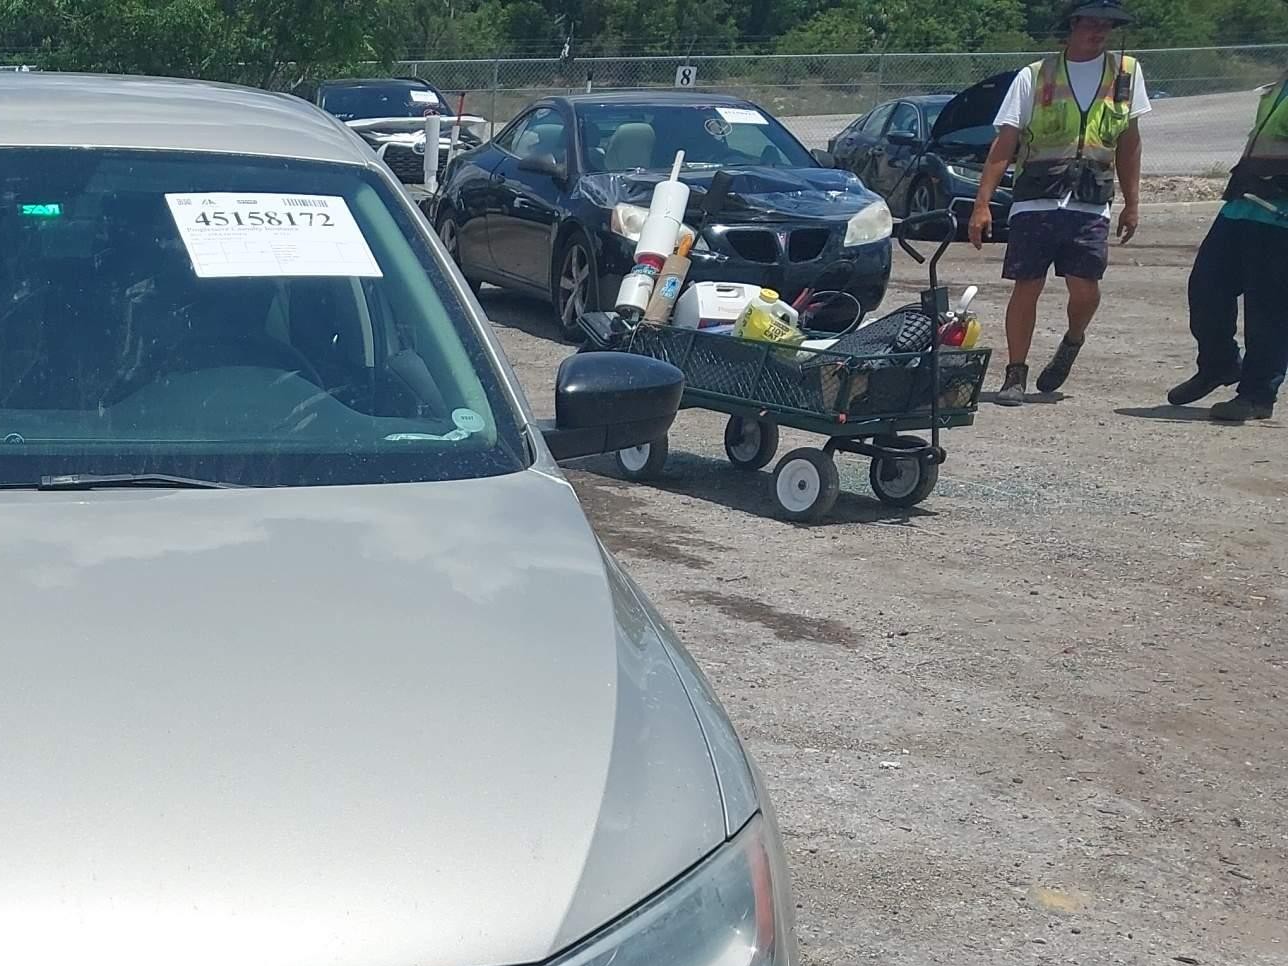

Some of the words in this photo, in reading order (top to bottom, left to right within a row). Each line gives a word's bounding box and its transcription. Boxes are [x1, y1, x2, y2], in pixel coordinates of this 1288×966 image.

[680, 68, 692, 86] 8
[194, 210, 335, 227] 45158172
[768, 324, 787, 337] TIDY
